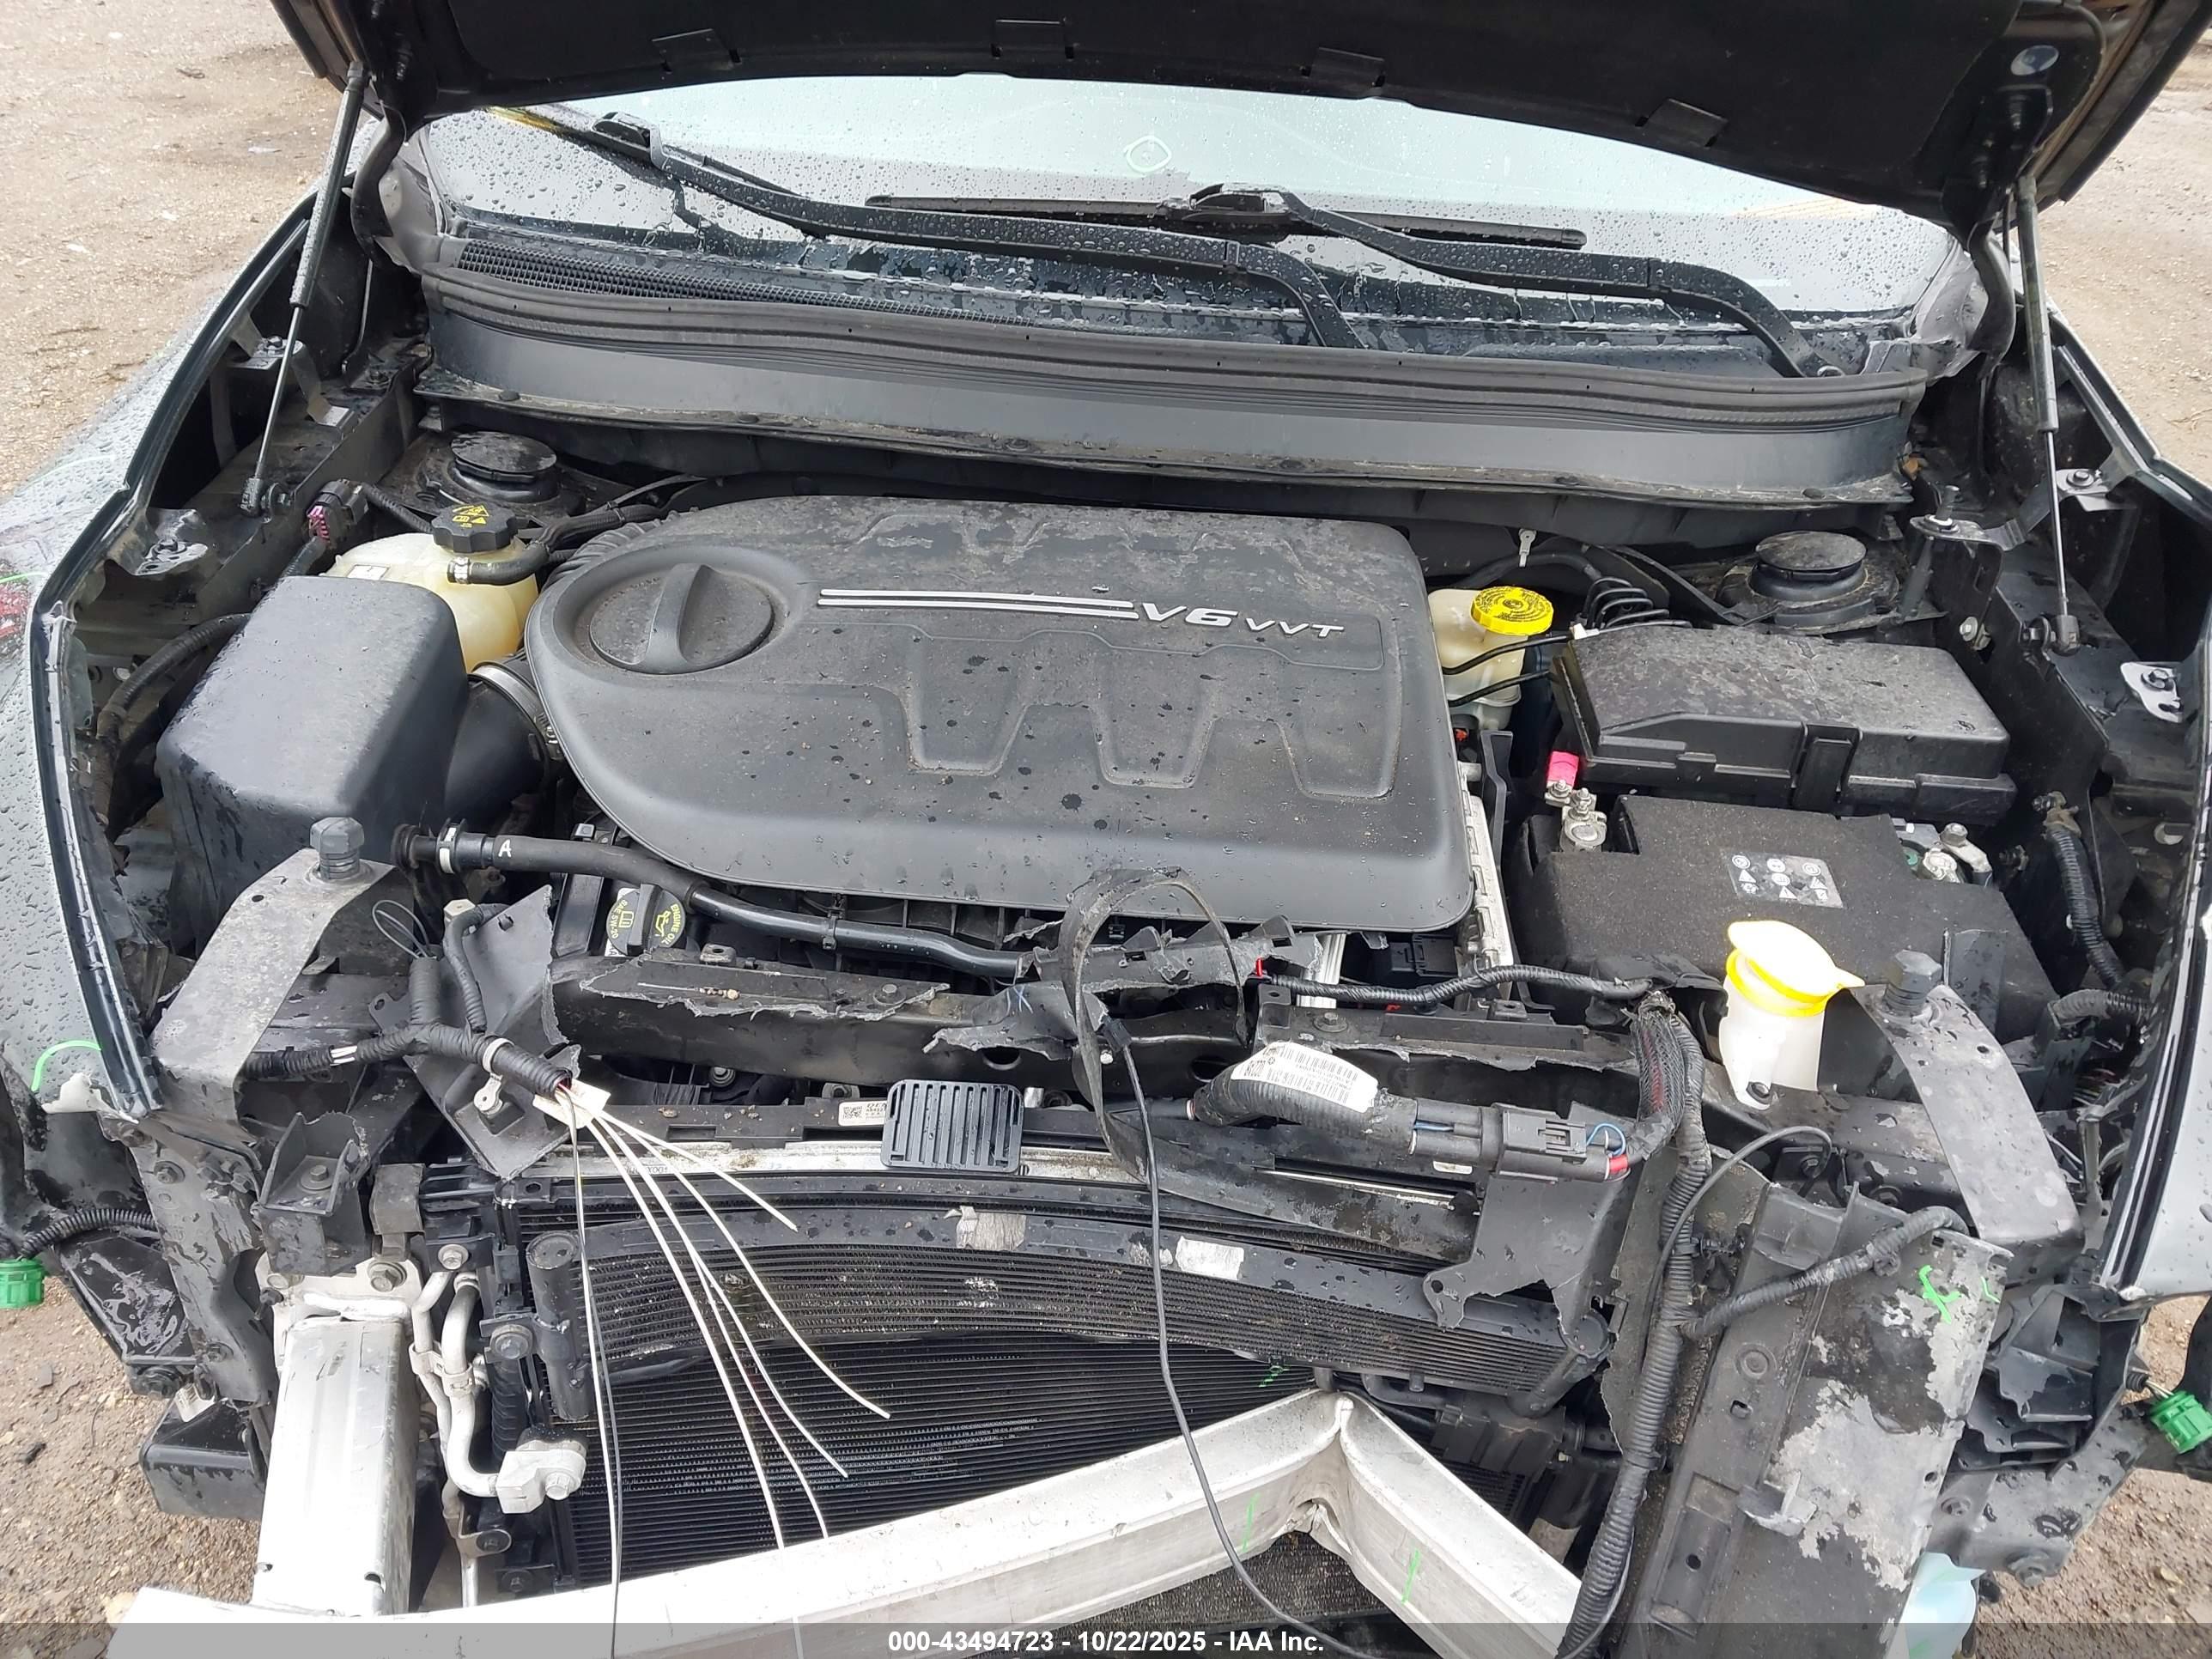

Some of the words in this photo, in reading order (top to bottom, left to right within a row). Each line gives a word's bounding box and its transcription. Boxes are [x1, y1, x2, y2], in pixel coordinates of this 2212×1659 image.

[1142, 603, 1239, 627] V6
[1246, 617, 1345, 638] VVT
[613, 899, 628, 915] SAE
[670, 903, 682, 933] ENGINE
[609, 915, 619, 939] 5W-20
[660, 933, 676, 945] OIL
